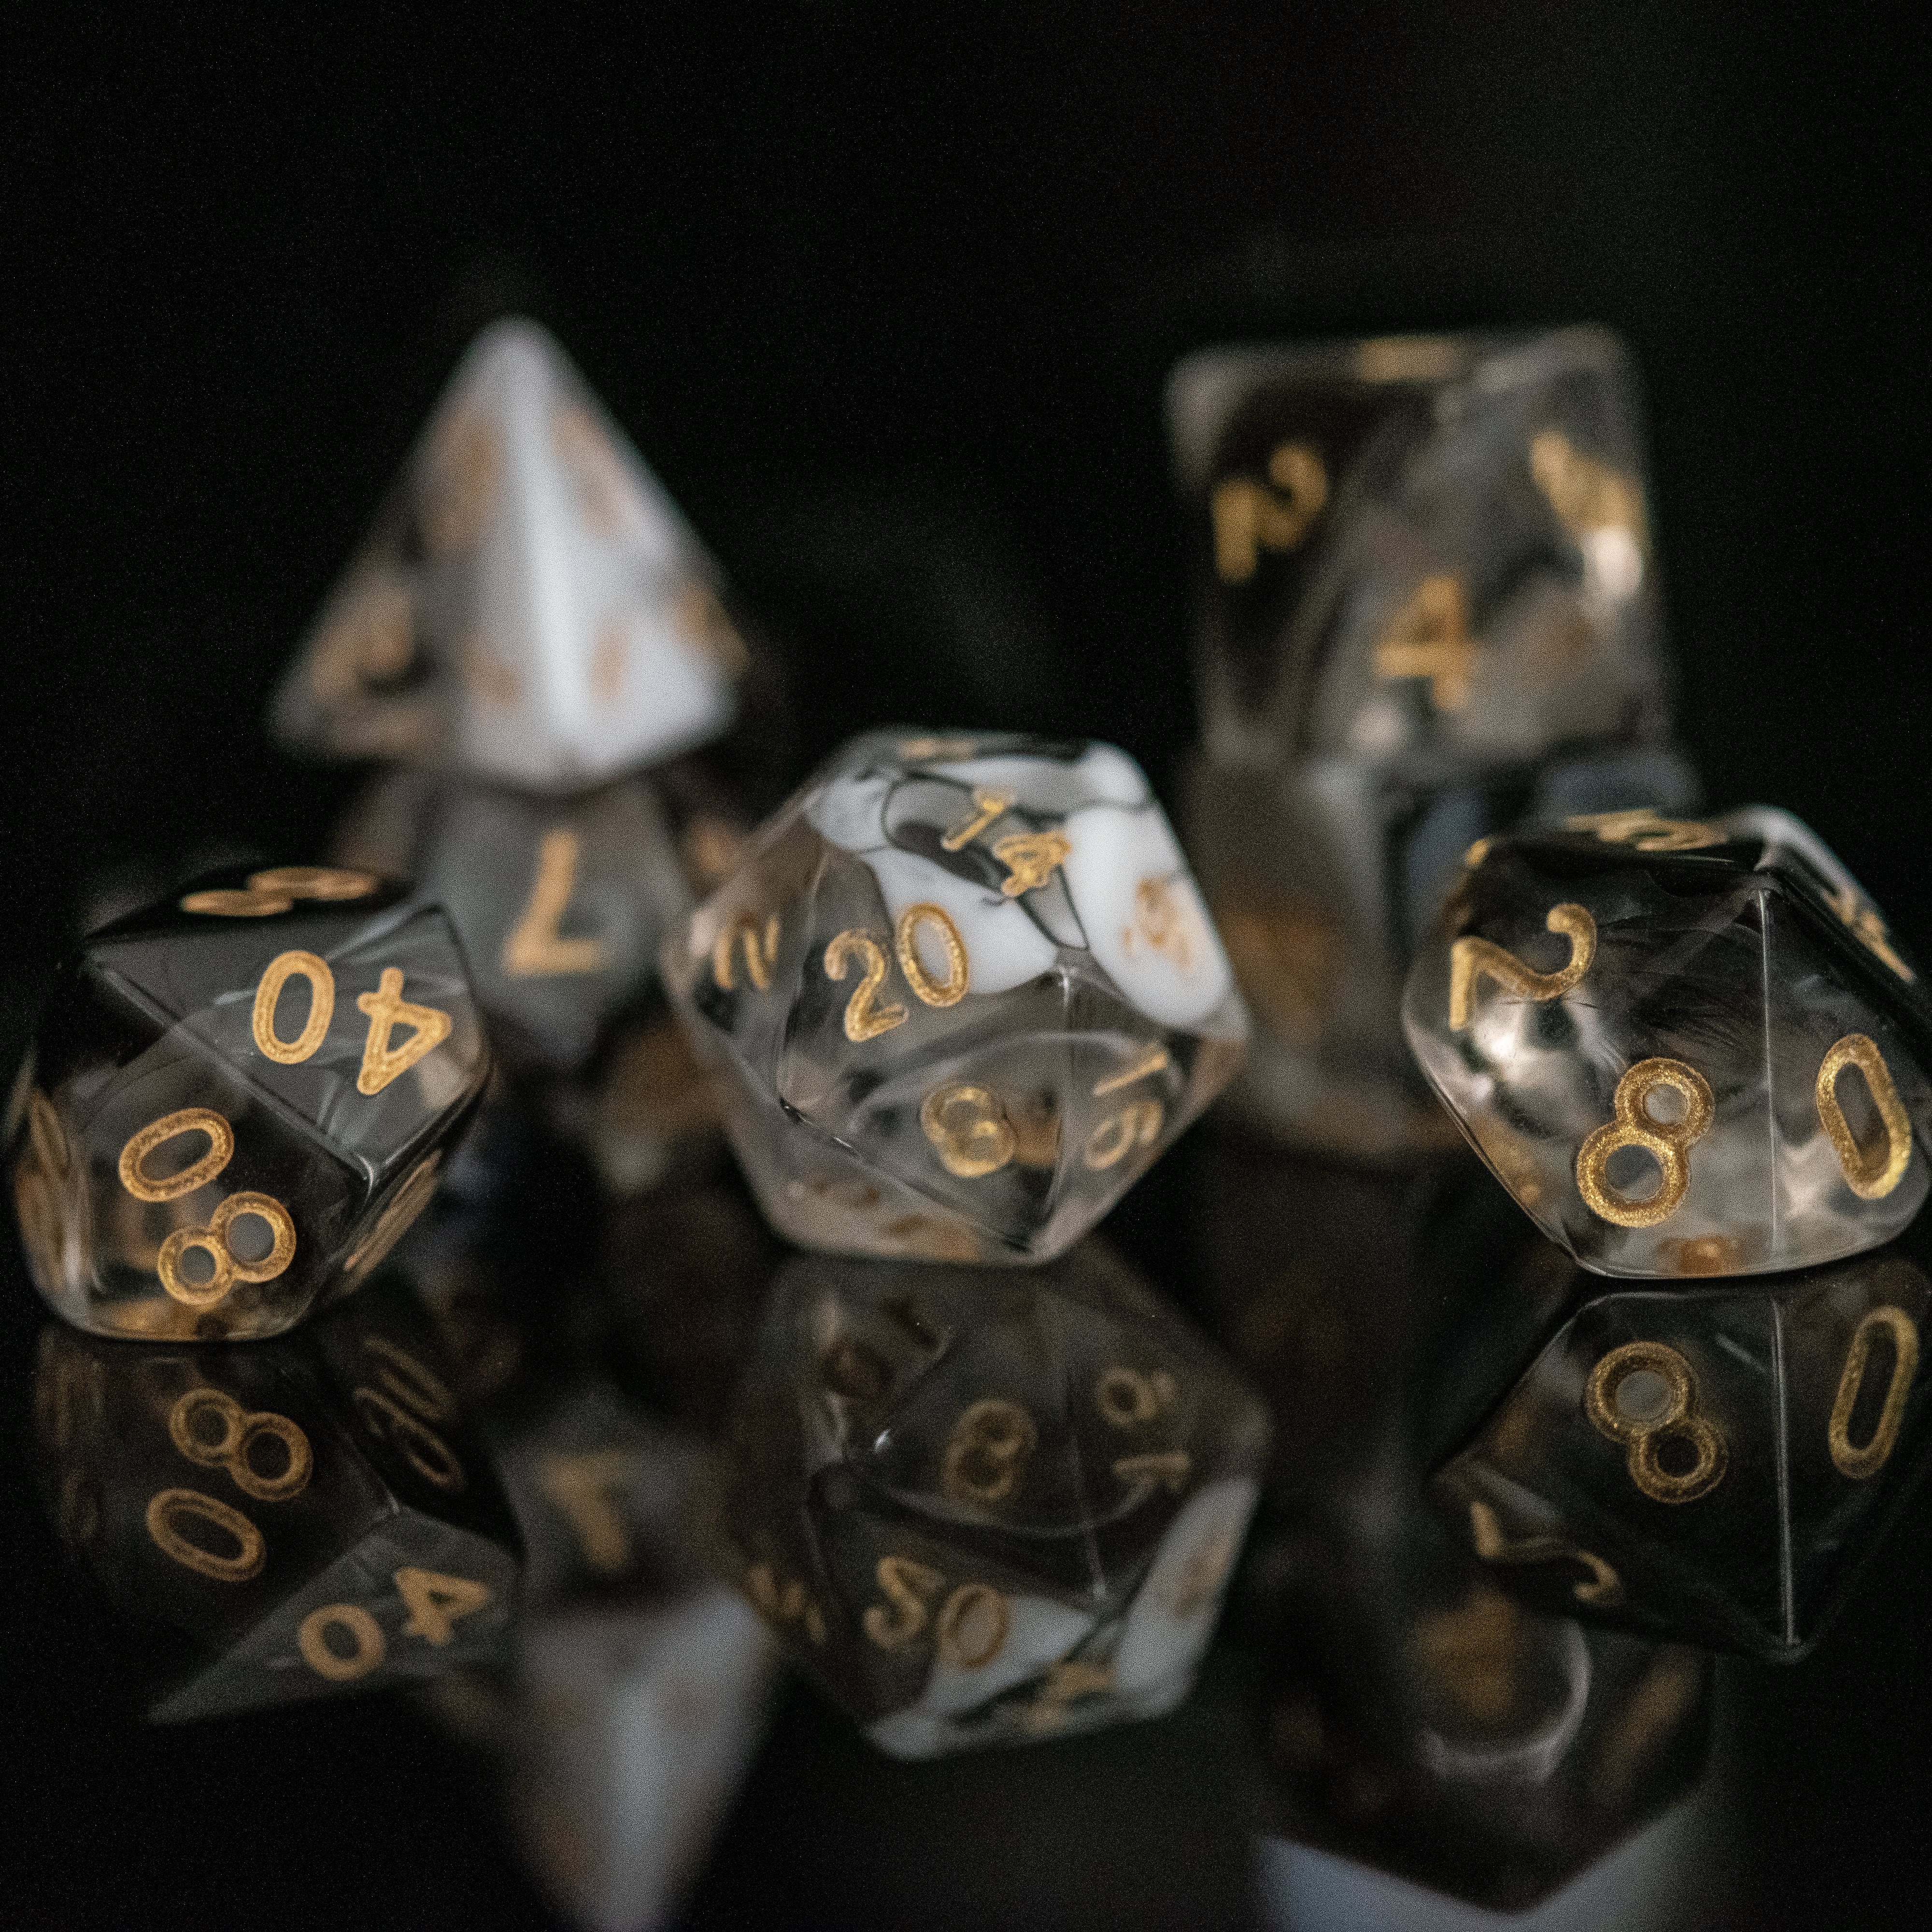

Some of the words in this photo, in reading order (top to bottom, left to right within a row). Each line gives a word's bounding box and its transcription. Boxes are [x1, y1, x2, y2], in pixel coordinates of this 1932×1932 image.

[1376, 576, 1476, 712] 4
[252, 950, 452, 1095] 40
[824, 901, 968, 1042] 20
[1450, 902, 1598, 1031] 2
[1577, 1057, 1715, 1228] 8
[1816, 1033, 1912, 1200] 0
[118, 1107, 297, 1306] 80
